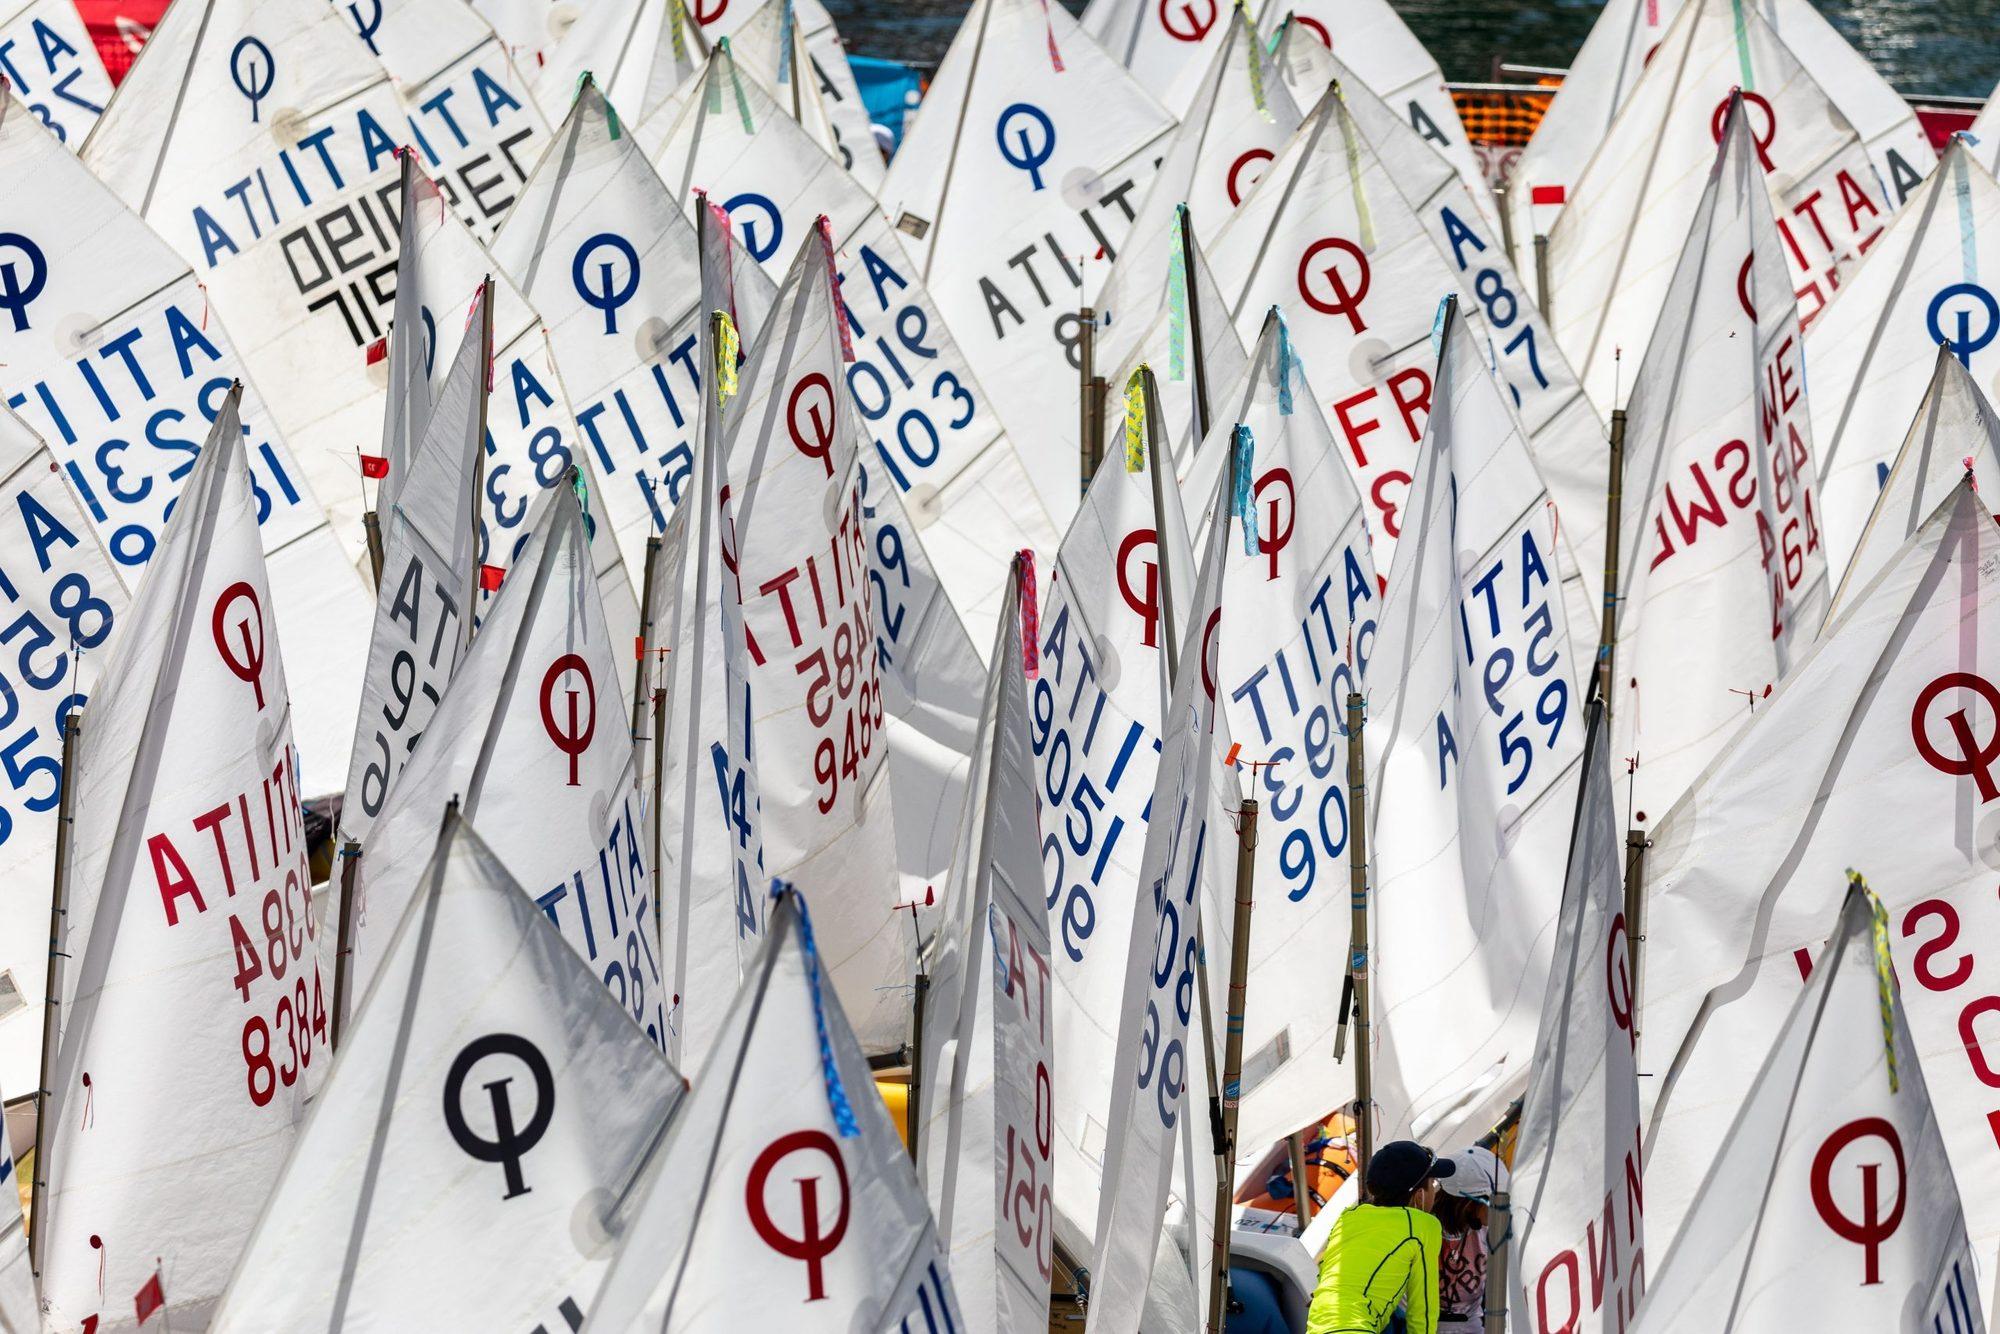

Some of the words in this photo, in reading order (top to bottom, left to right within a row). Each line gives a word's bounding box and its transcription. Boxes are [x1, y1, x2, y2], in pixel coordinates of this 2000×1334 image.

[77, 305, 222, 422] ITA
[1460, 529, 1550, 666] ITA
[814, 645, 883, 815] 9485
[242, 955, 327, 1107] 8384
